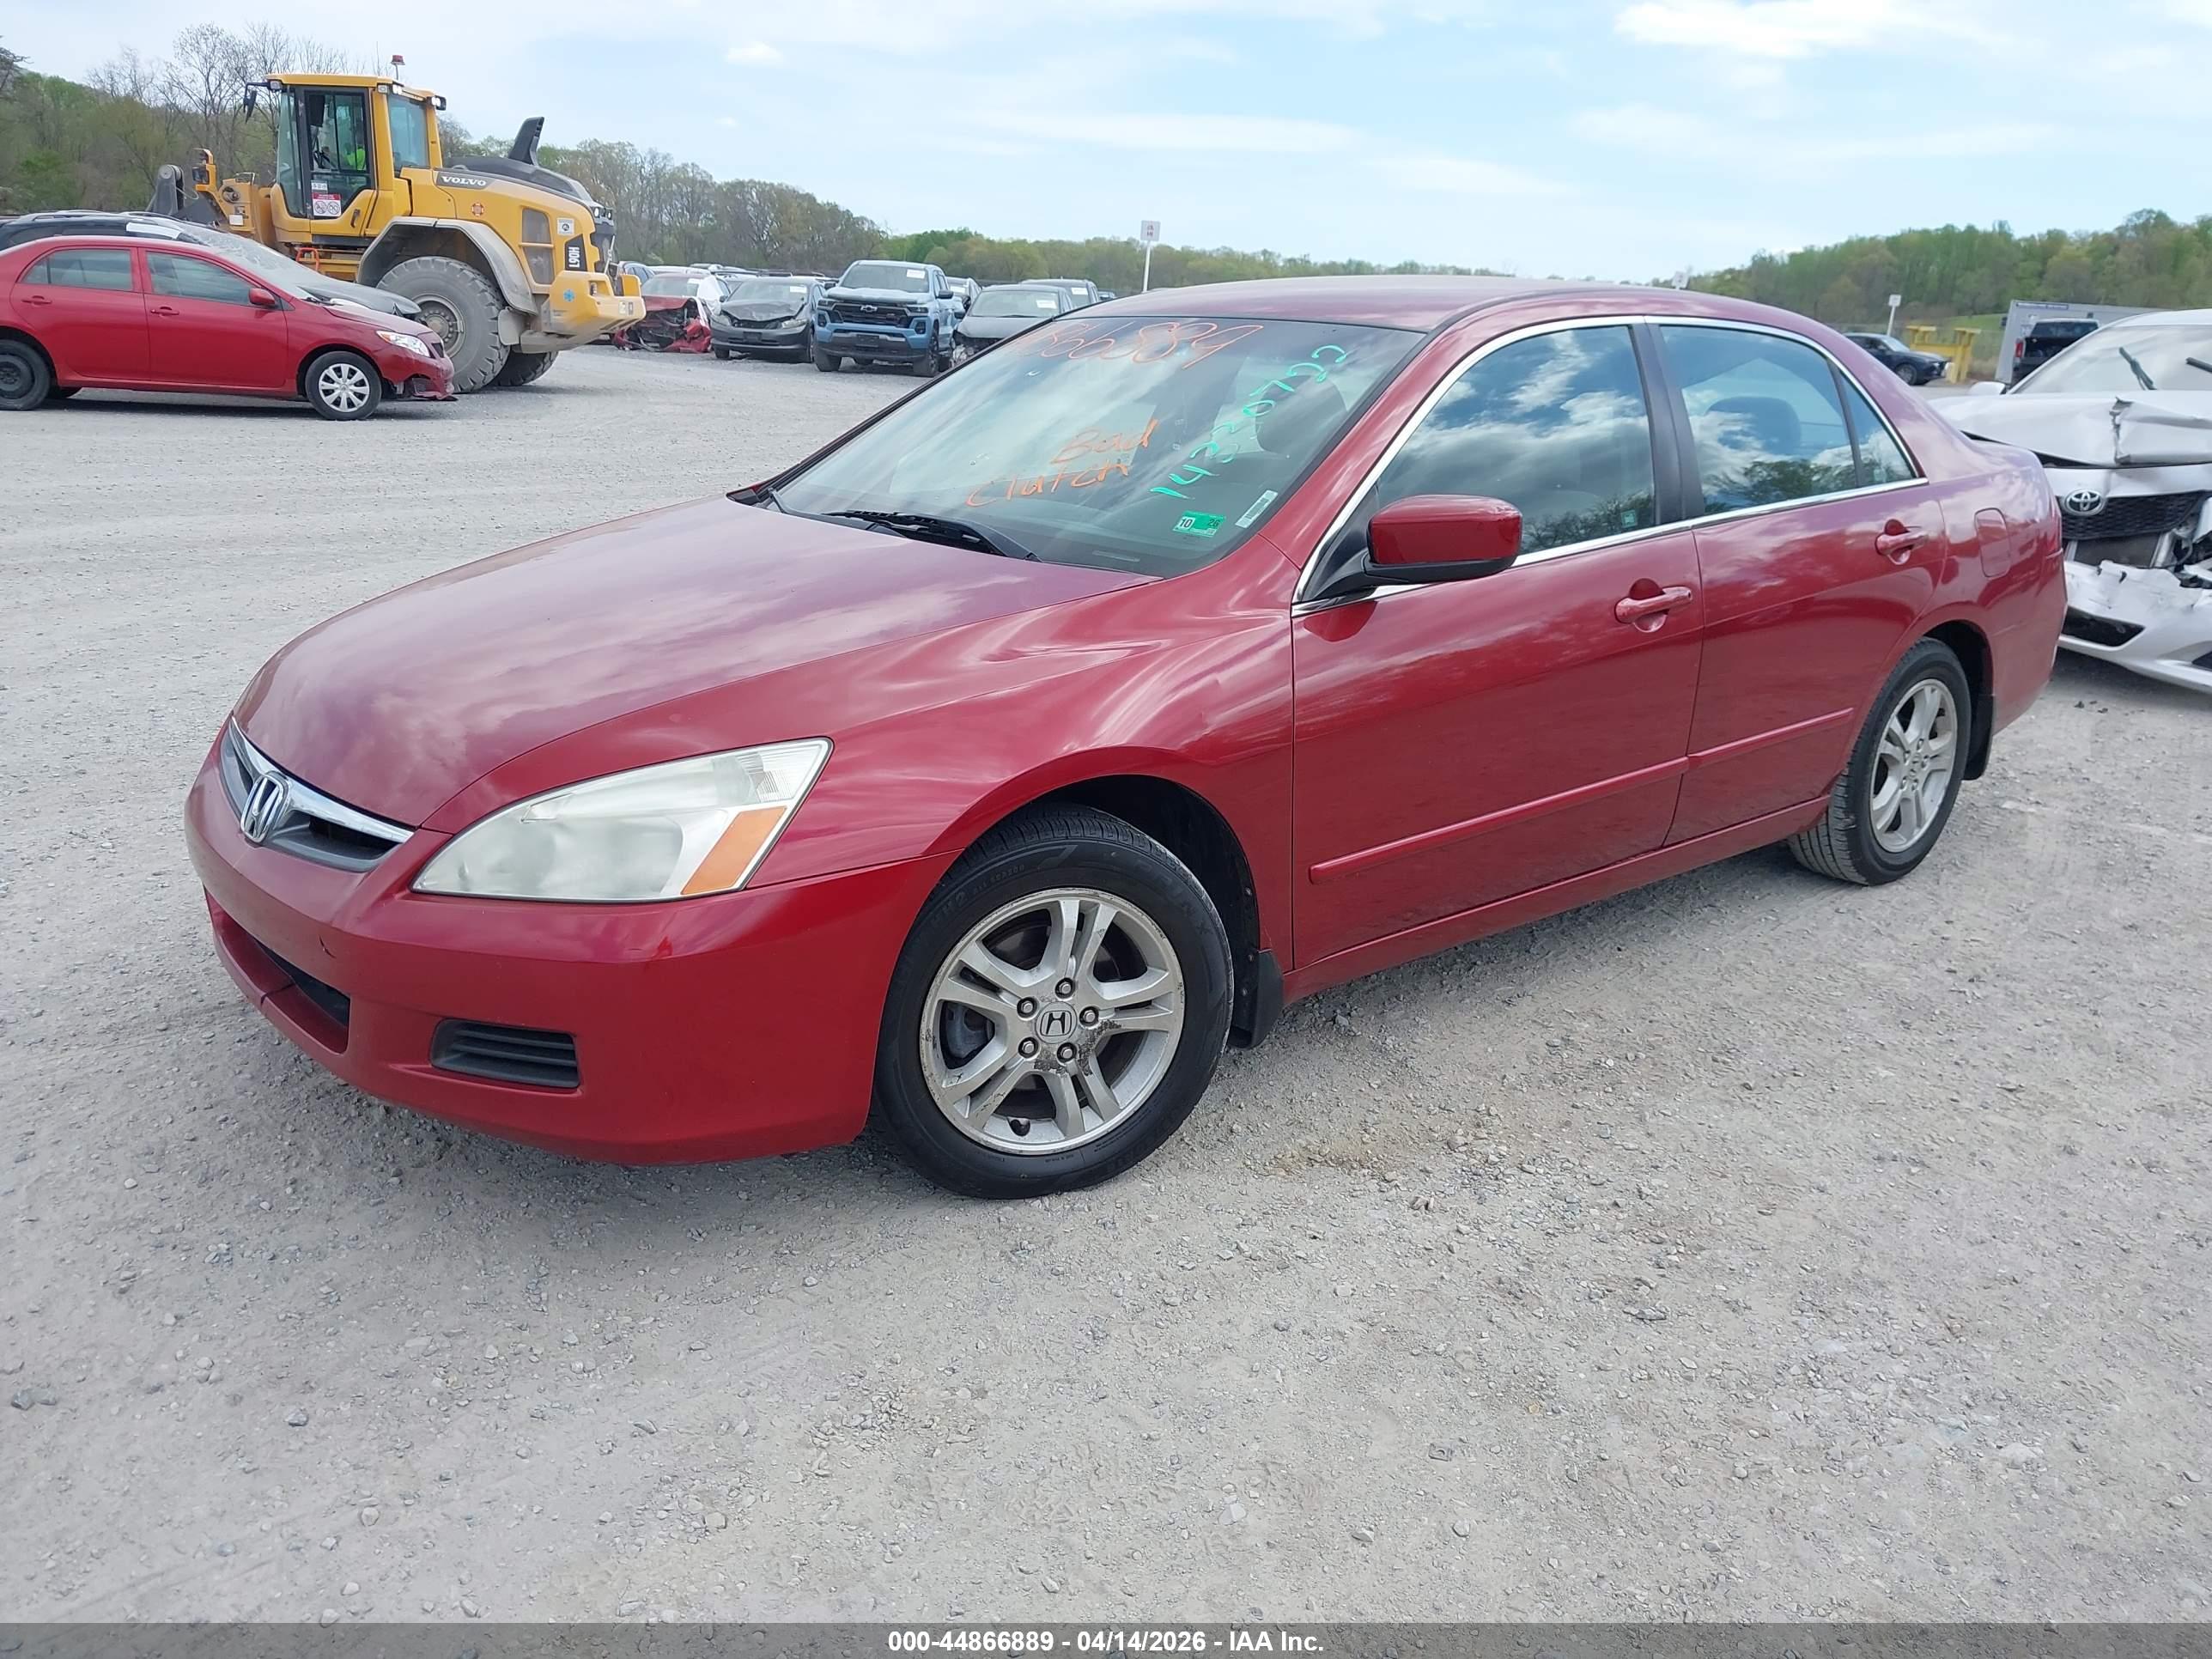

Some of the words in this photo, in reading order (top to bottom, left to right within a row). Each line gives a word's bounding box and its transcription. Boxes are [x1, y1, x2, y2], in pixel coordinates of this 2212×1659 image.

[441, 175, 487, 186] VOLVO
[568, 246, 580, 268] L90H
[1049, 418, 1159, 465] Bad
[1181, 518, 1194, 529] 10
